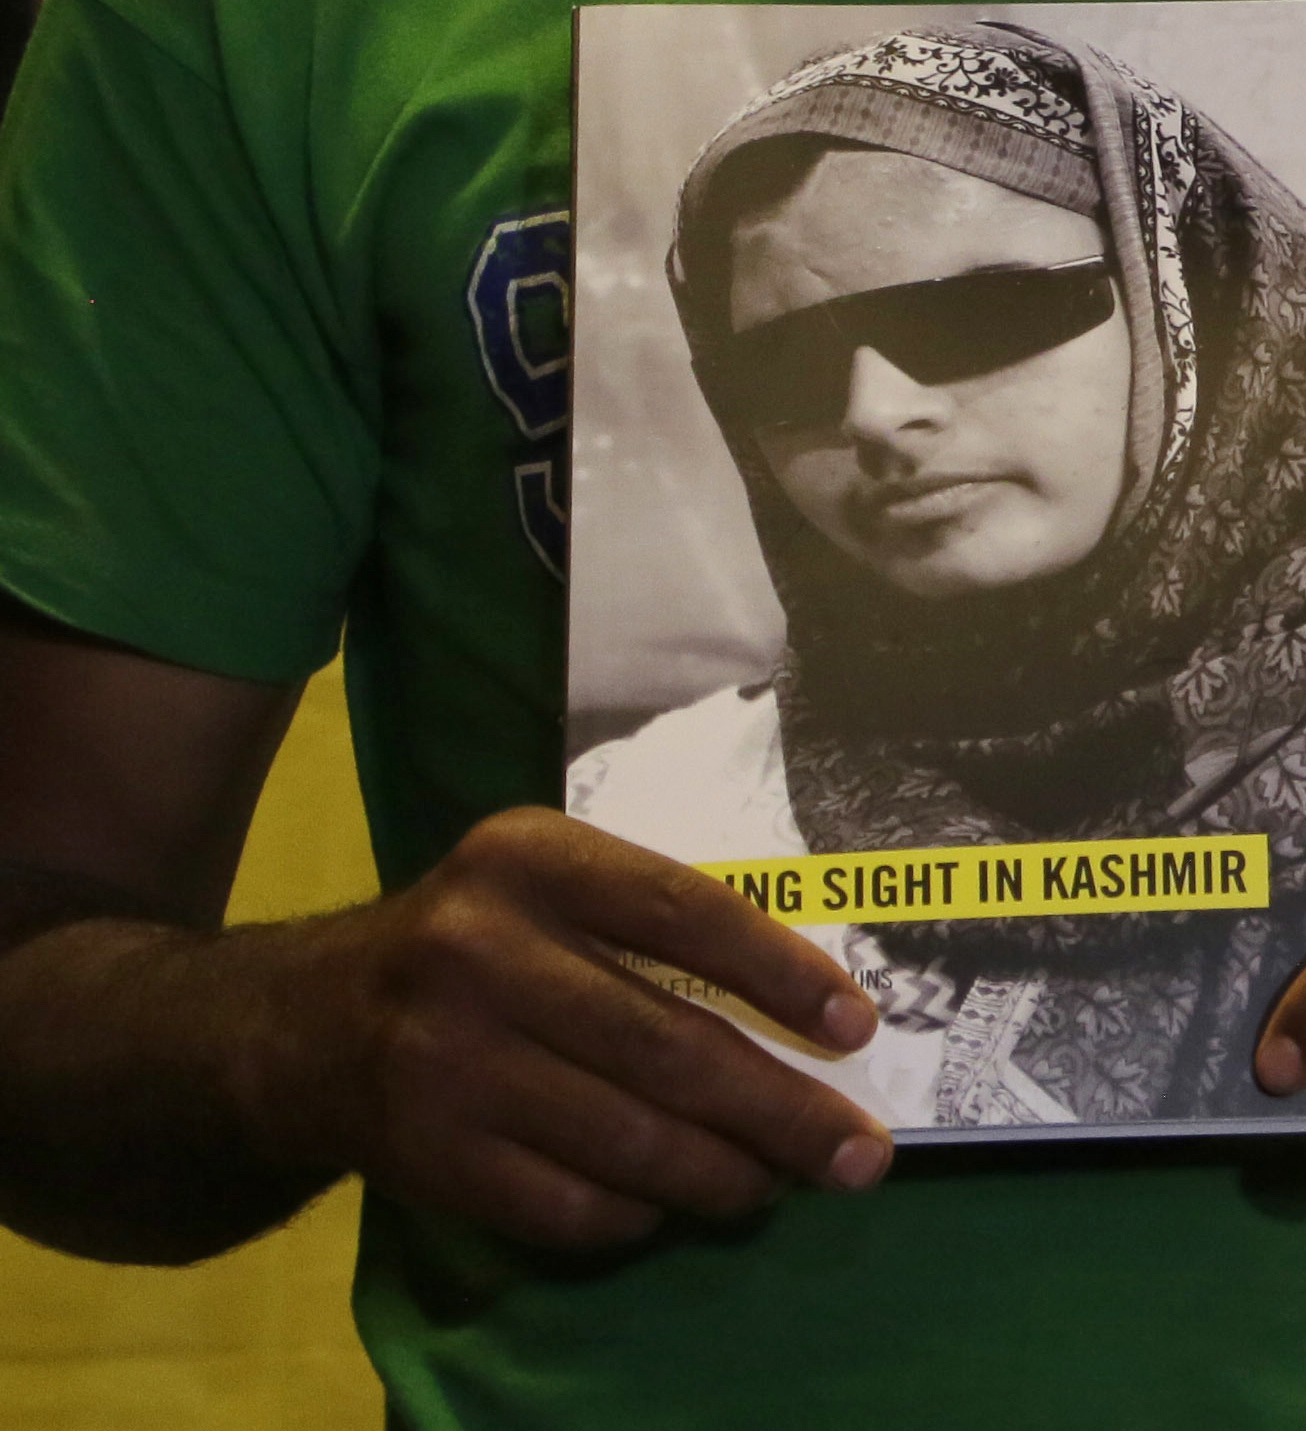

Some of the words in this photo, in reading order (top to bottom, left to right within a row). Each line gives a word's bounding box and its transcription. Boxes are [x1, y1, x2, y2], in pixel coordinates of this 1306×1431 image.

[822, 861, 959, 911] SIGHT
[979, 857, 1023, 903] IN
[1042, 849, 1247, 900] KASHMIR
